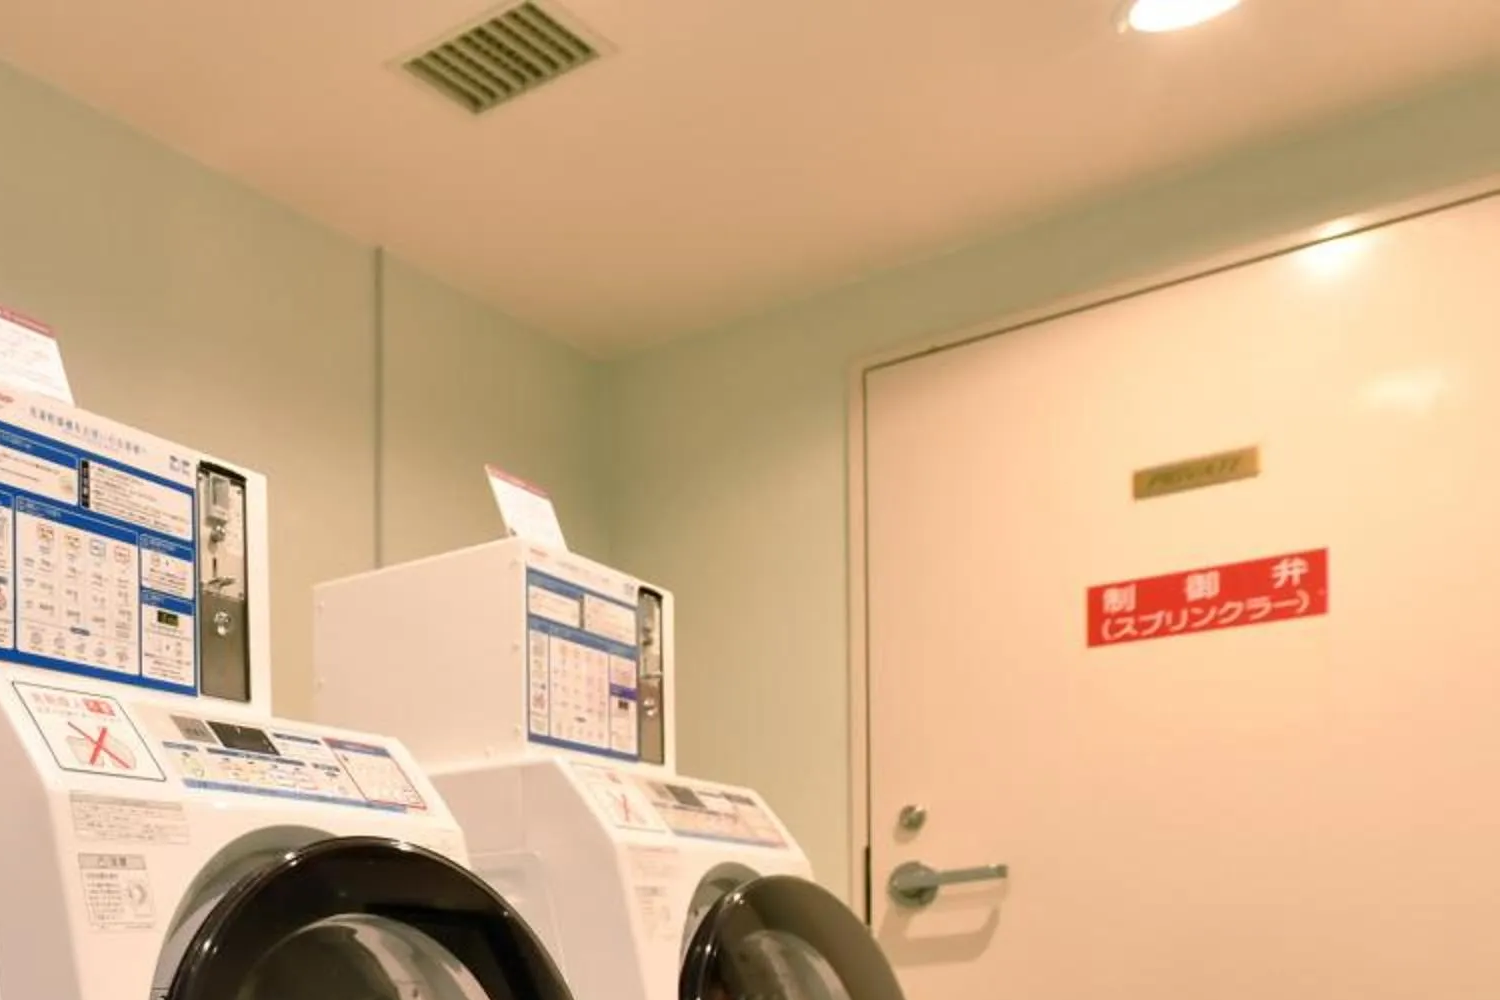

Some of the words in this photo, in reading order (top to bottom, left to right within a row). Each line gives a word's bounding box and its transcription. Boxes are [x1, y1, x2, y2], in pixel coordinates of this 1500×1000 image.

[1103, 557, 1308, 614] 制御弁
[1102, 589, 1310, 641] (スプリンクラー)
